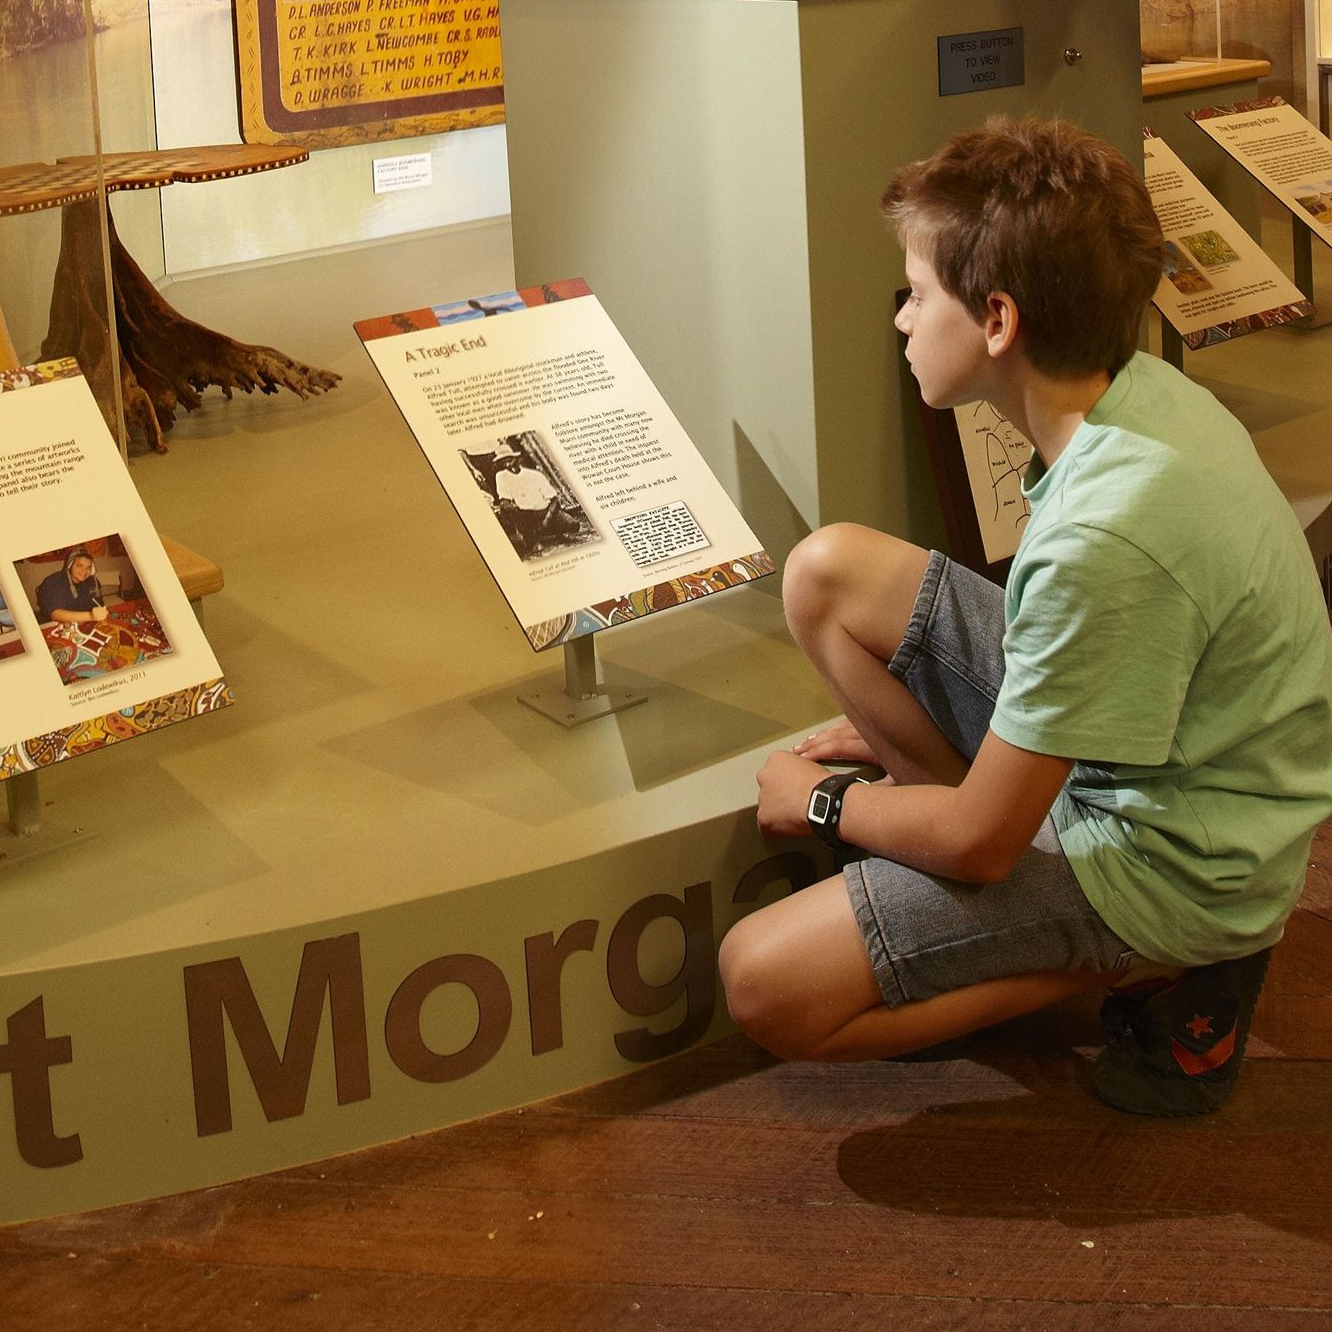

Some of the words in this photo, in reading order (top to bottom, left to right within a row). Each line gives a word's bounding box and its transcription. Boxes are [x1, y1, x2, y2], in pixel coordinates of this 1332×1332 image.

[950, 40, 977, 53] PRESS
[981, 36, 1014, 50] BUTTON
[965, 58, 977, 68] TO
[980, 54, 1001, 65] VIEW
[971, 72, 996, 84] VIDEO
[405, 351, 416, 363] A
[417, 342, 460, 365] Tragic
[462, 335, 487, 351] End
[413, 369, 433, 379] Panel
[9, 469, 23, 477] the
[24, 460, 62, 473] mountain
[63, 454, 85, 464] range
